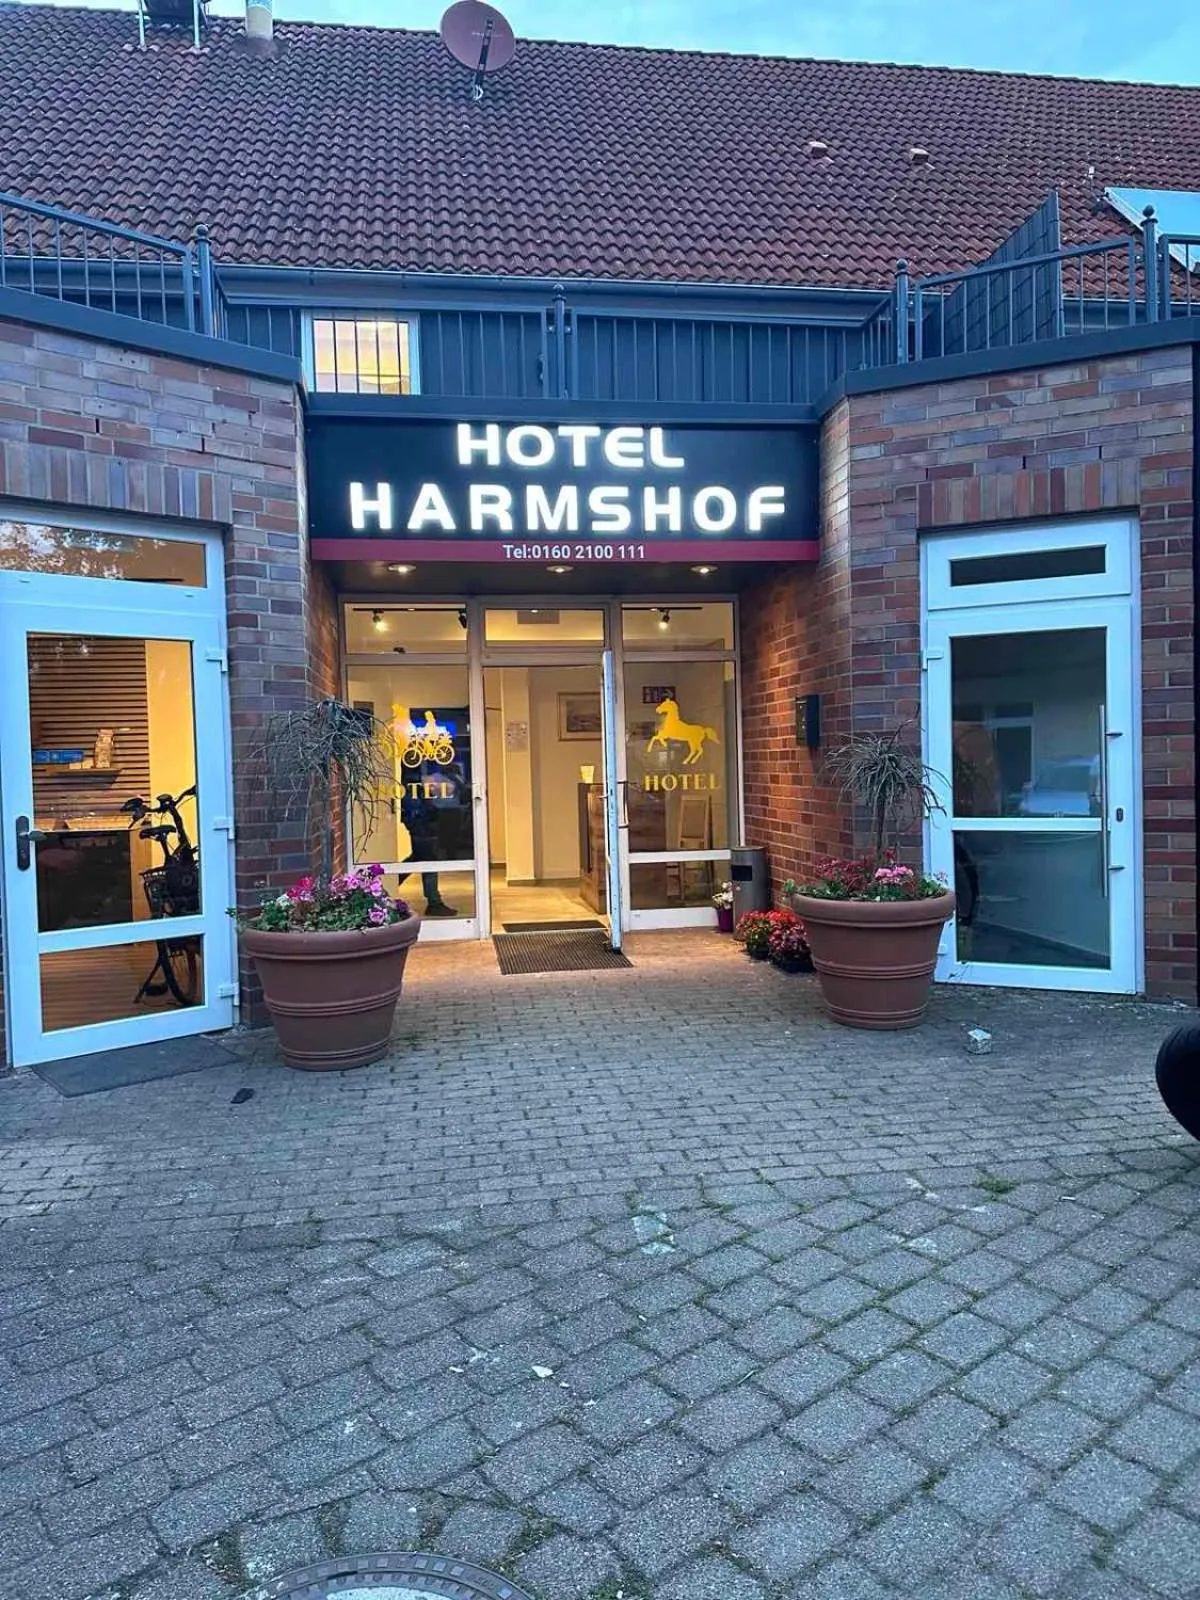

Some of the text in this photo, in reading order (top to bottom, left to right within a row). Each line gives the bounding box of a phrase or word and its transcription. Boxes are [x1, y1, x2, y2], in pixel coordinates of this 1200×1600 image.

[457, 423, 685, 468] HOTEL
[349, 482, 786, 532] HARMSHOF
[503, 544, 645, 559] Tel:0160 2100 111
[644, 773, 720, 791] HOTEL
